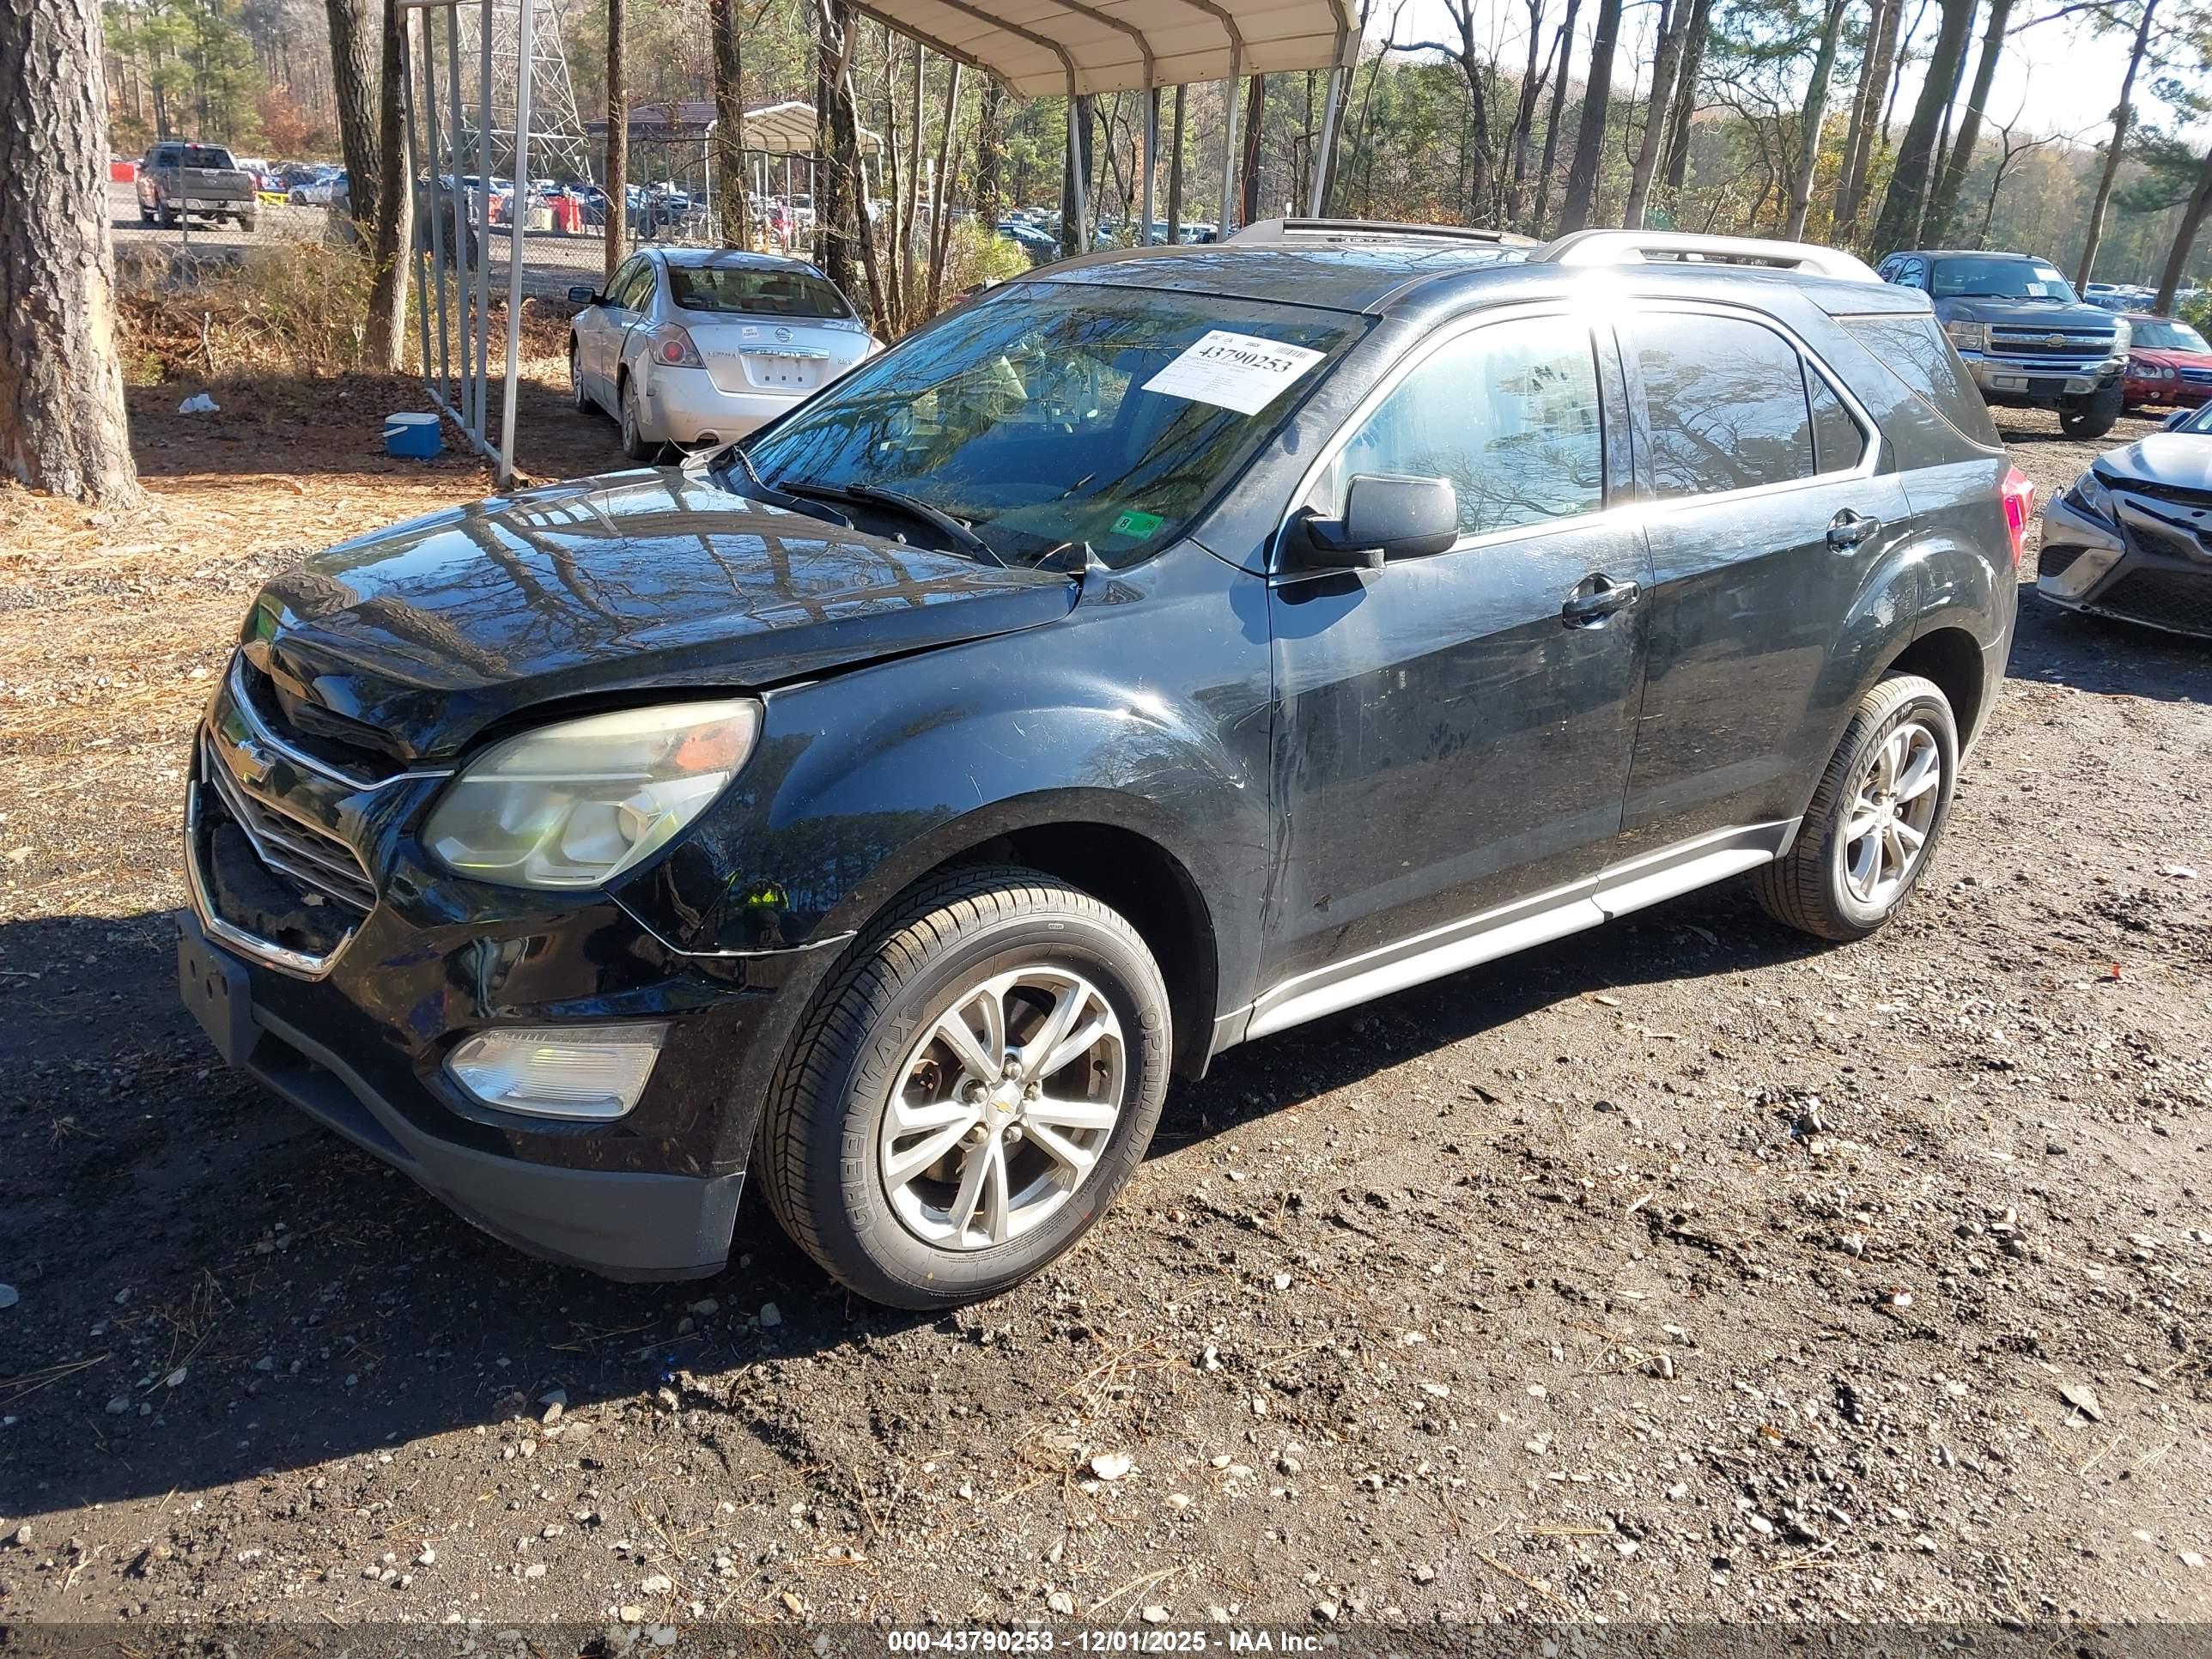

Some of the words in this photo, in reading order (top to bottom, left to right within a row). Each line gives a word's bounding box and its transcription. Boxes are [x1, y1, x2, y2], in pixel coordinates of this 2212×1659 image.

[1199, 345, 1293, 373] 43790253
[1120, 518, 1129, 528] 8
[1840, 713, 1899, 816] OPTIMUM
[1900, 702, 1913, 718] HP
[840, 1003, 917, 1234] GREENMAX
[1121, 1009, 1164, 1169] OPTIMUM
[1104, 1173, 1126, 1207] HP
